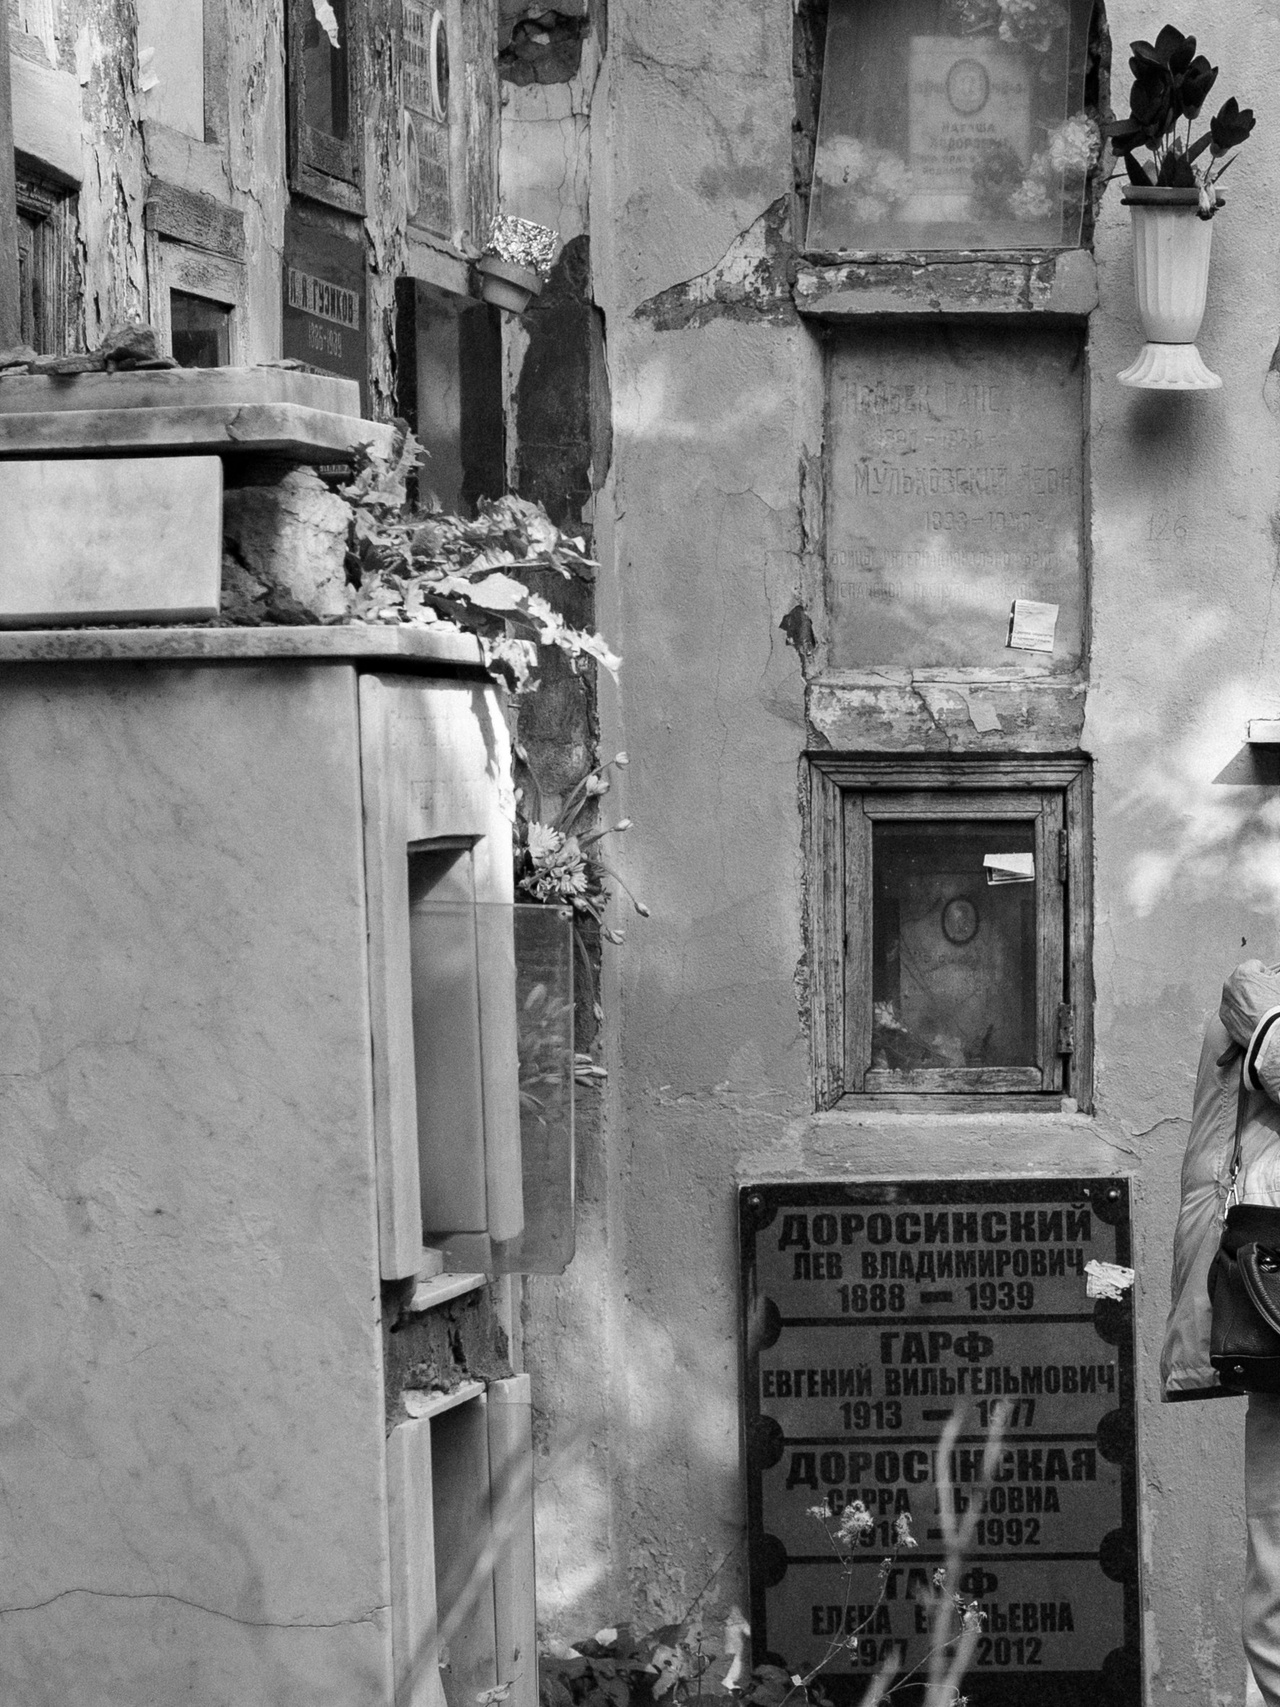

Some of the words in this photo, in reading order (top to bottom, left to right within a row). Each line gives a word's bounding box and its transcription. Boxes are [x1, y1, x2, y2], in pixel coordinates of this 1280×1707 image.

[778, 1203, 1092, 1251] ДОРОСИНСКИЙ
[793, 1252, 843, 1281] ЛЕВ
[861, 1248, 1084, 1283] ВЛАДИМИРОВИЧ
[838, 1283, 907, 1313] 1888
[966, 1282, 1035, 1311] 1939
[880, 1331, 994, 1365] ГАРФ
[762, 1363, 872, 1398] ЕВГЕНИЙ
[885, 1365, 1114, 1396] ВИЛЬГЕЛЬМОВИЧ
[839, 1402, 901, 1430] 1913
[976, 1518, 1041, 1546] 1992
[886, 1567, 998, 1600] ГАФ
[811, 1605, 892, 1636] ЕЛЕНА
[914, 1602, 1075, 1635] ЕЬЕВНА
[977, 1637, 1042, 1666] 2012
